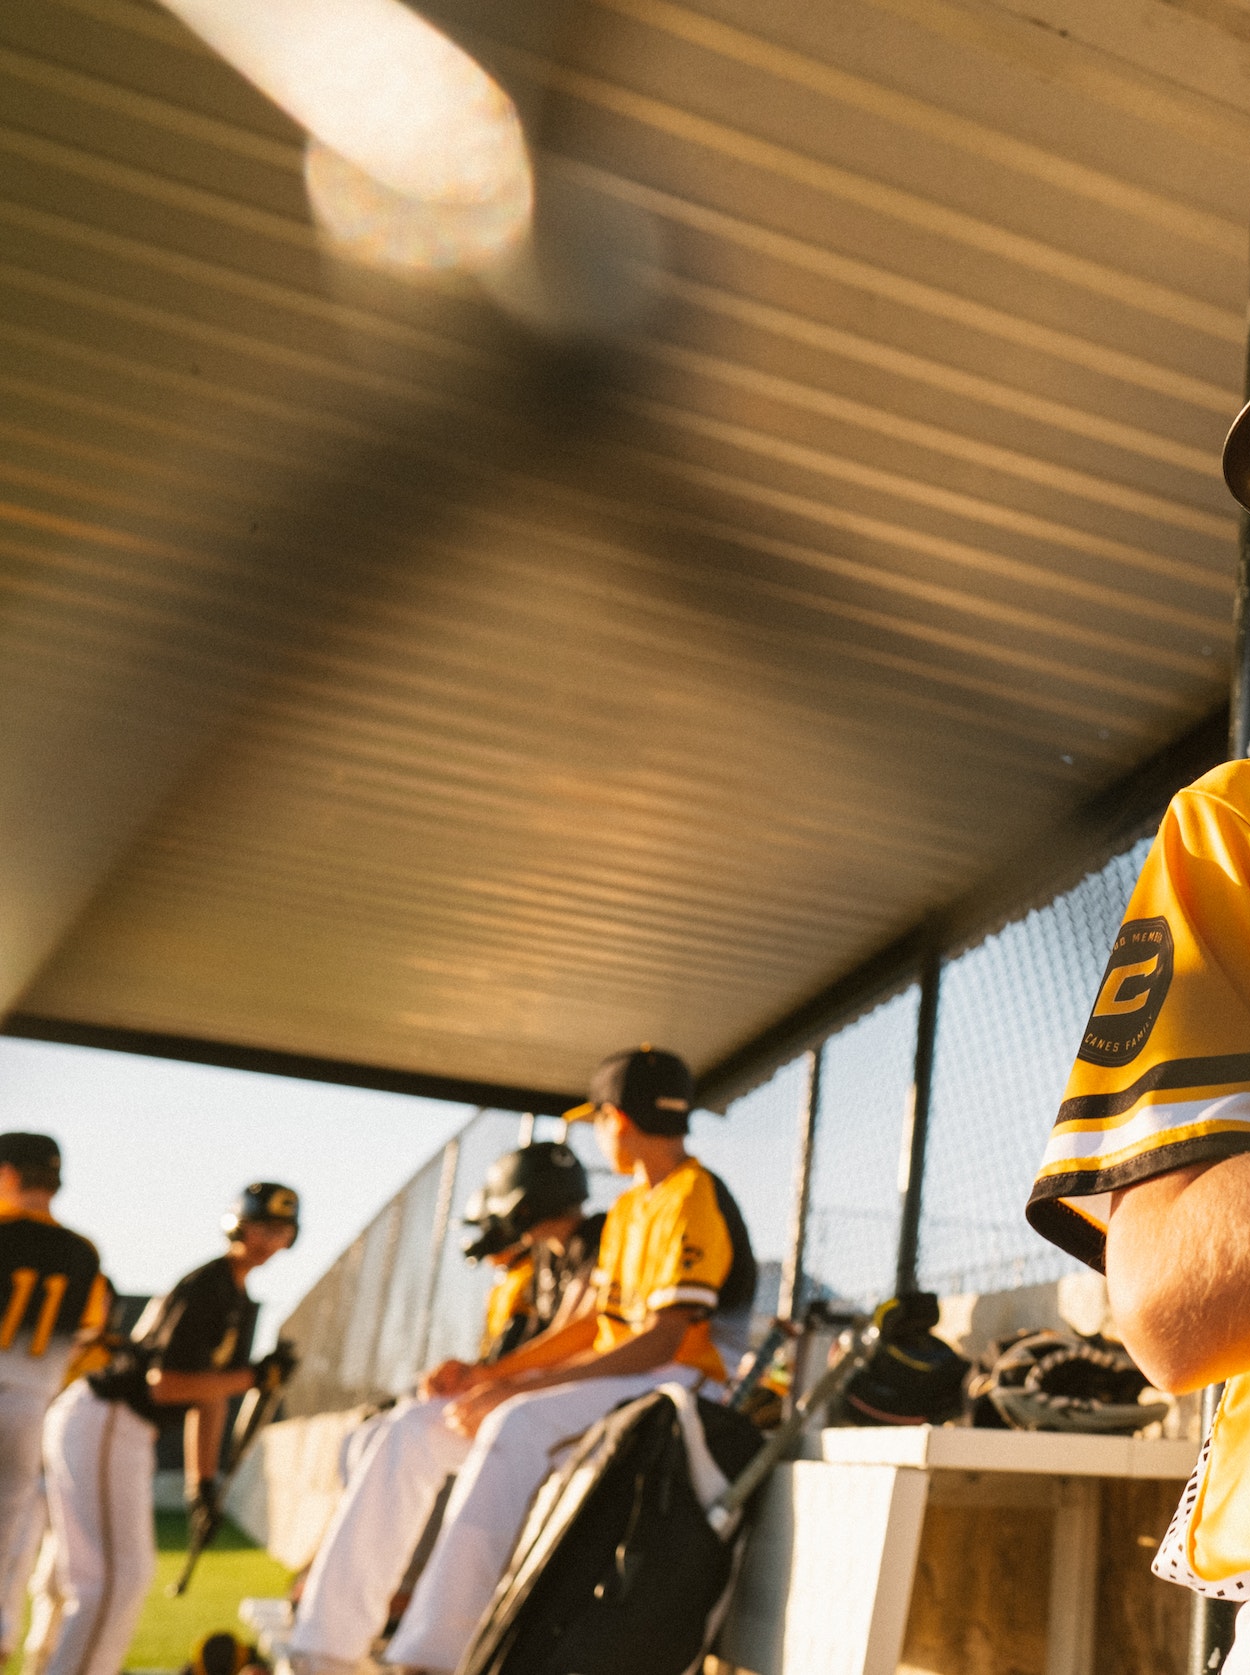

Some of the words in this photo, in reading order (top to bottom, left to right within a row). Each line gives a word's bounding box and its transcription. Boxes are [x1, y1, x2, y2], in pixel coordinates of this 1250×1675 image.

[1093, 953, 1159, 1018] C
[1084, 1032, 1120, 1054] CANES
[1125, 1015, 1153, 1051] FAMILY
[0, 1266, 68, 1357] 11
